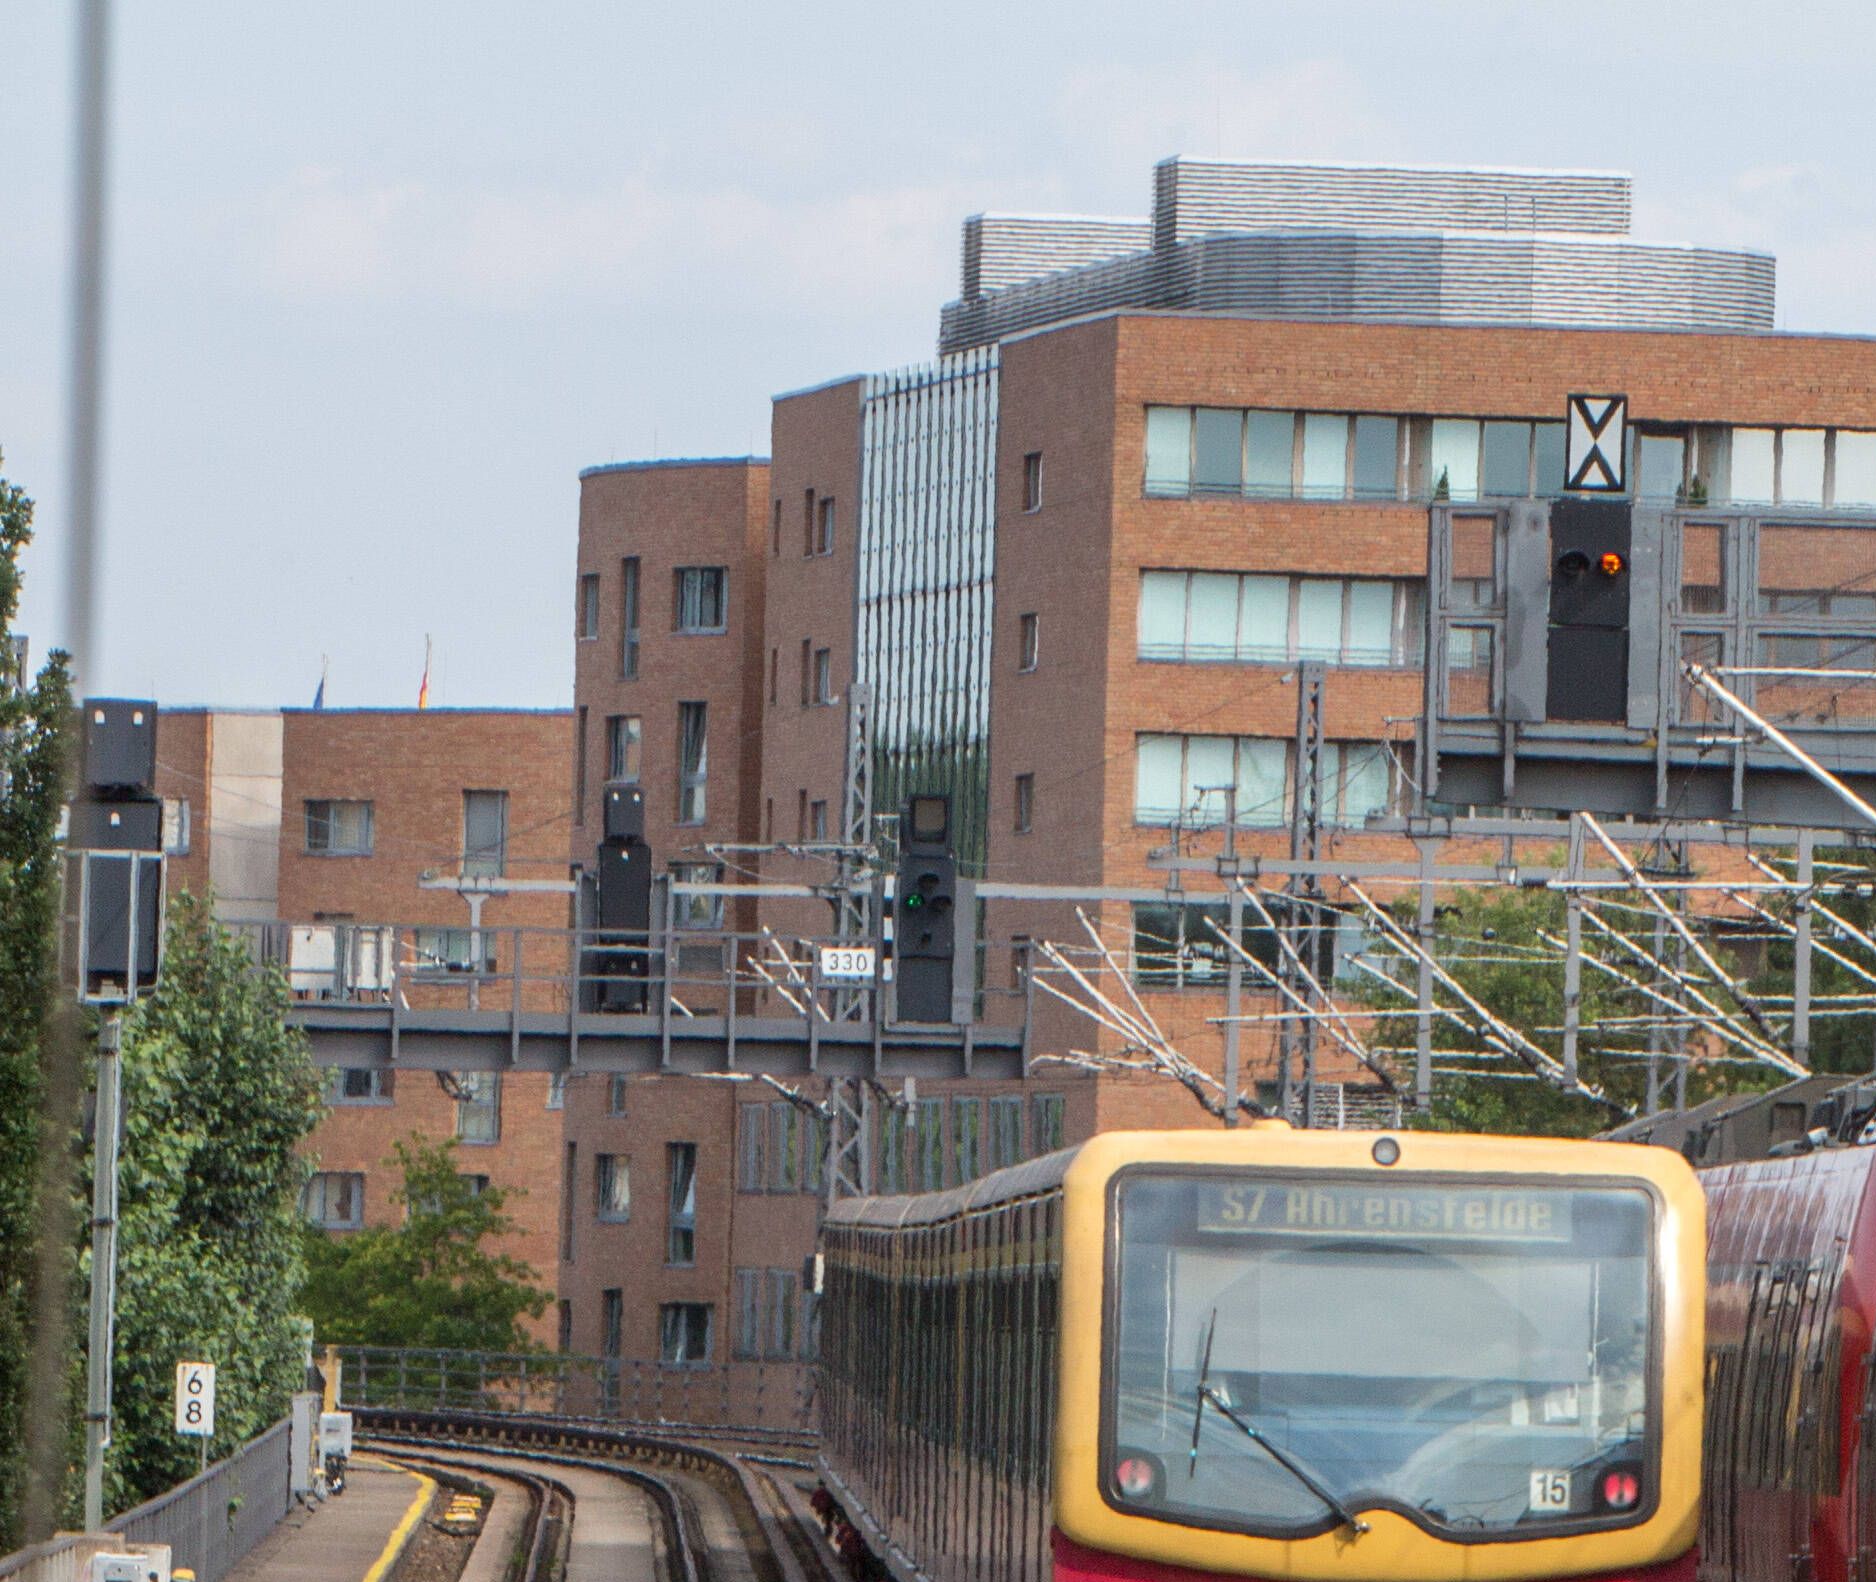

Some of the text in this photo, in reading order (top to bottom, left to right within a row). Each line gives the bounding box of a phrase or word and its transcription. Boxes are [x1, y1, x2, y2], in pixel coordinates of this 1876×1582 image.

[829, 952, 868, 972] 330
[1221, 1187, 1267, 1223] S7
[1535, 1474, 1567, 1505] 15
